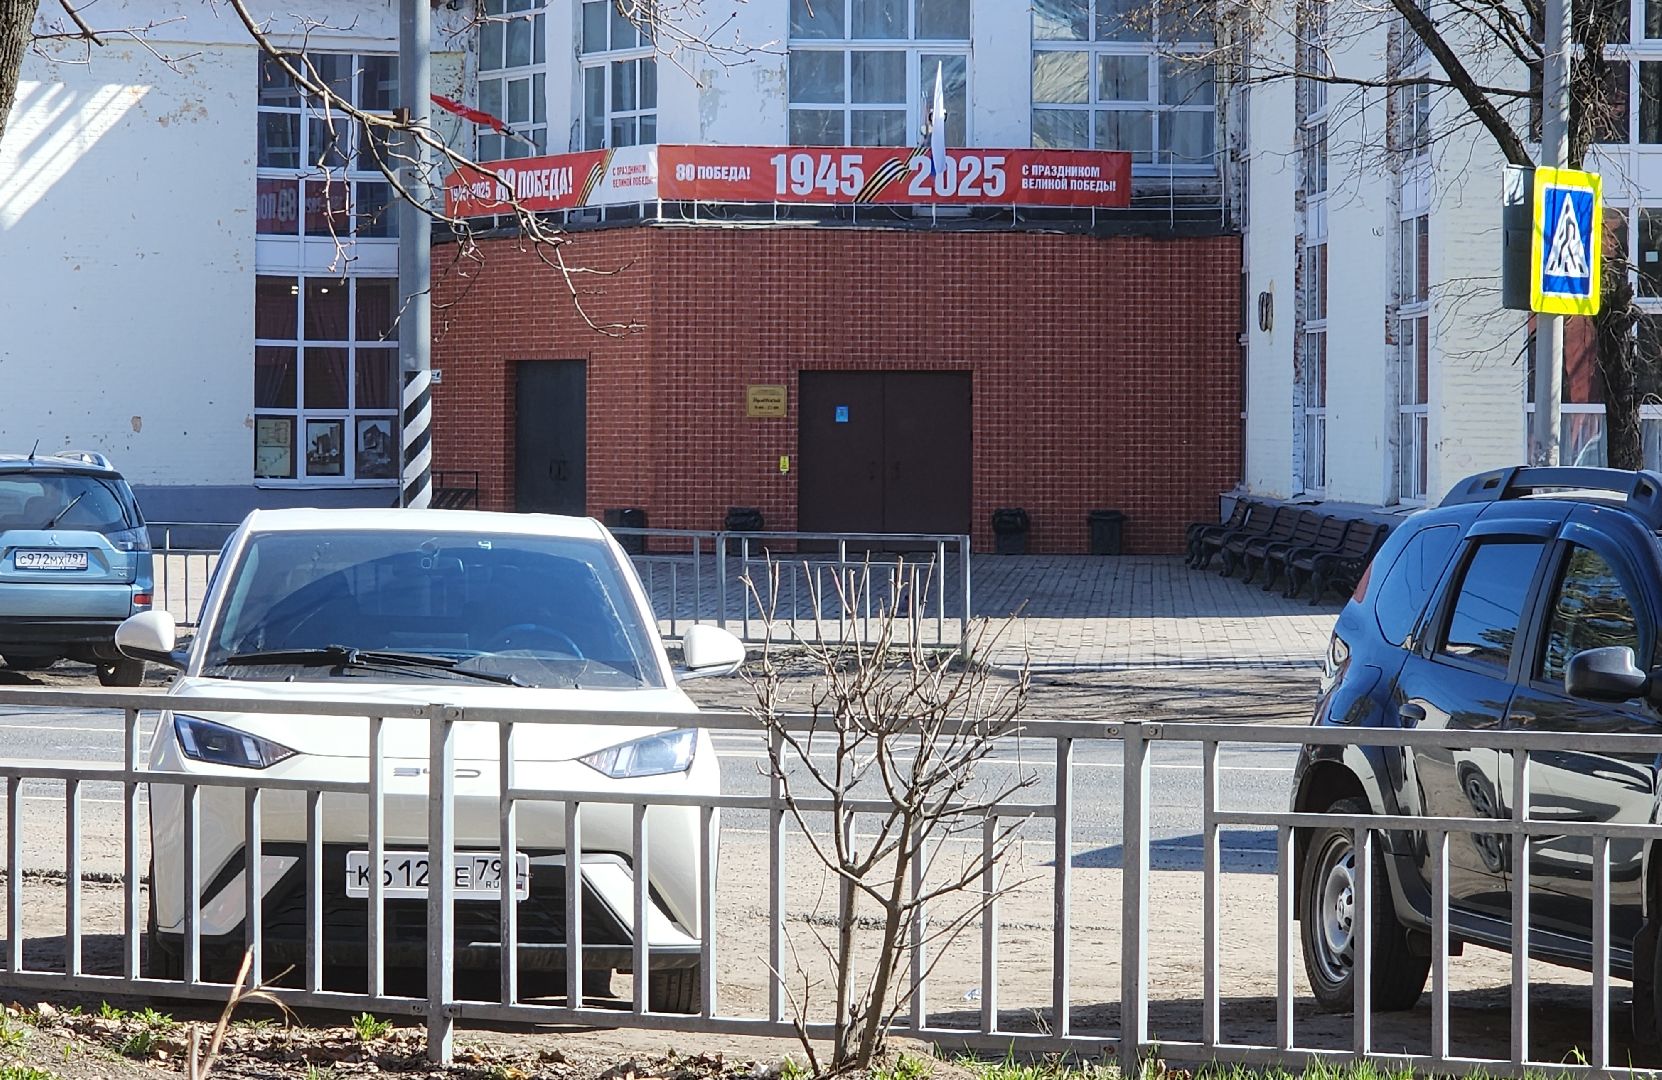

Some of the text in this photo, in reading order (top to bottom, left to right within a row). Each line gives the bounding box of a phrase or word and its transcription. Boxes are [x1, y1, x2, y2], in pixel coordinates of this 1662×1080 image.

[676, 164, 751, 182] 80 ПОБЕДА!
[770, 153, 1006, 197] 1945 2025
[1022, 164, 1101, 178] С ПРАЗДНИКОМ
[495, 168, 516, 201] 80
[517, 166, 573, 201] ПОБЕДА!
[1021, 178, 1117, 193] ВЕЛИКОЙ ПОБЕДЫ!
[19, 553, 84, 565] С972МХ 797
[358, 859, 519, 887] К612Е 79
[486, 880, 500, 889] RU
